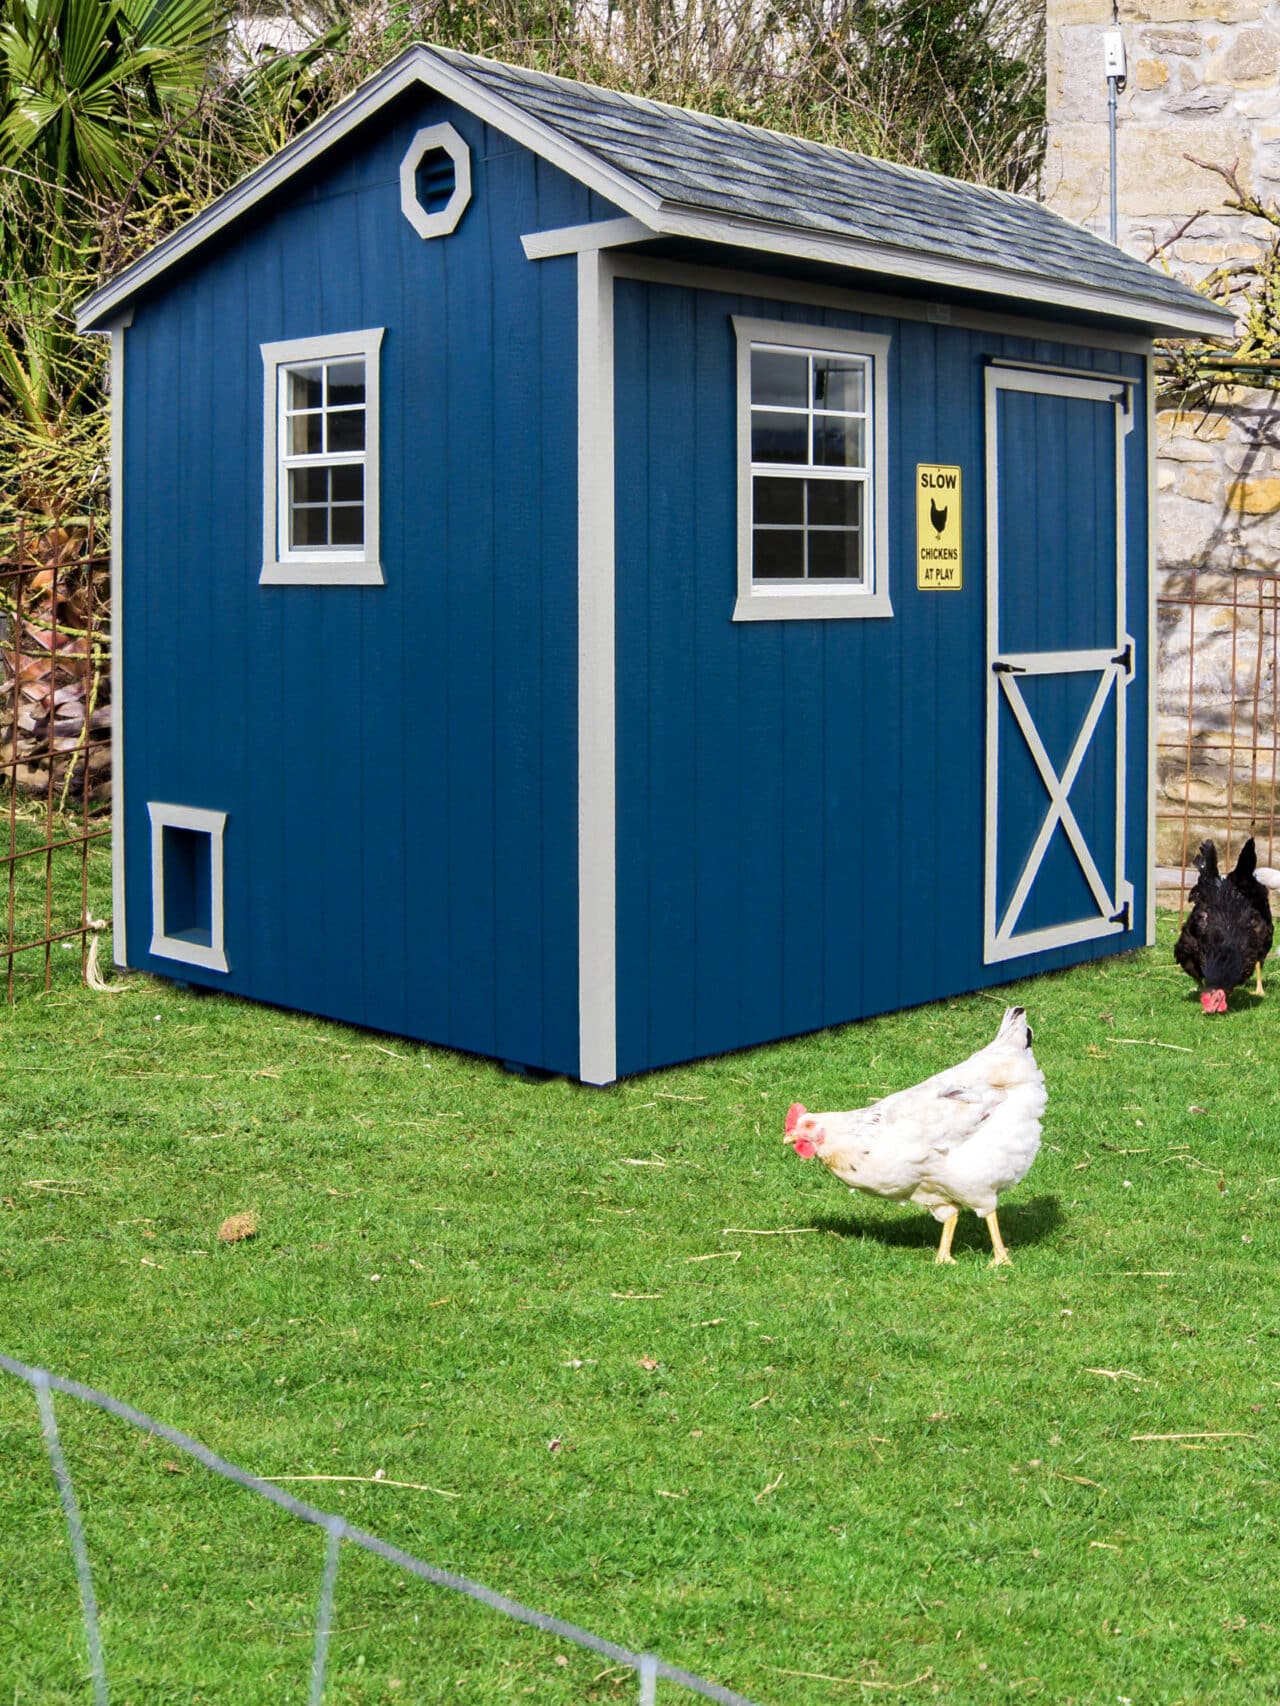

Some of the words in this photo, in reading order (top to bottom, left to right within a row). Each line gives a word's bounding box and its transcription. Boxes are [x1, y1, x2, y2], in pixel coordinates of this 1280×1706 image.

[921, 473, 956, 489] SLOW
[921, 548, 958, 560] CHICKENS
[925, 568, 934, 580] AT
[936, 568, 954, 580] PLAY
